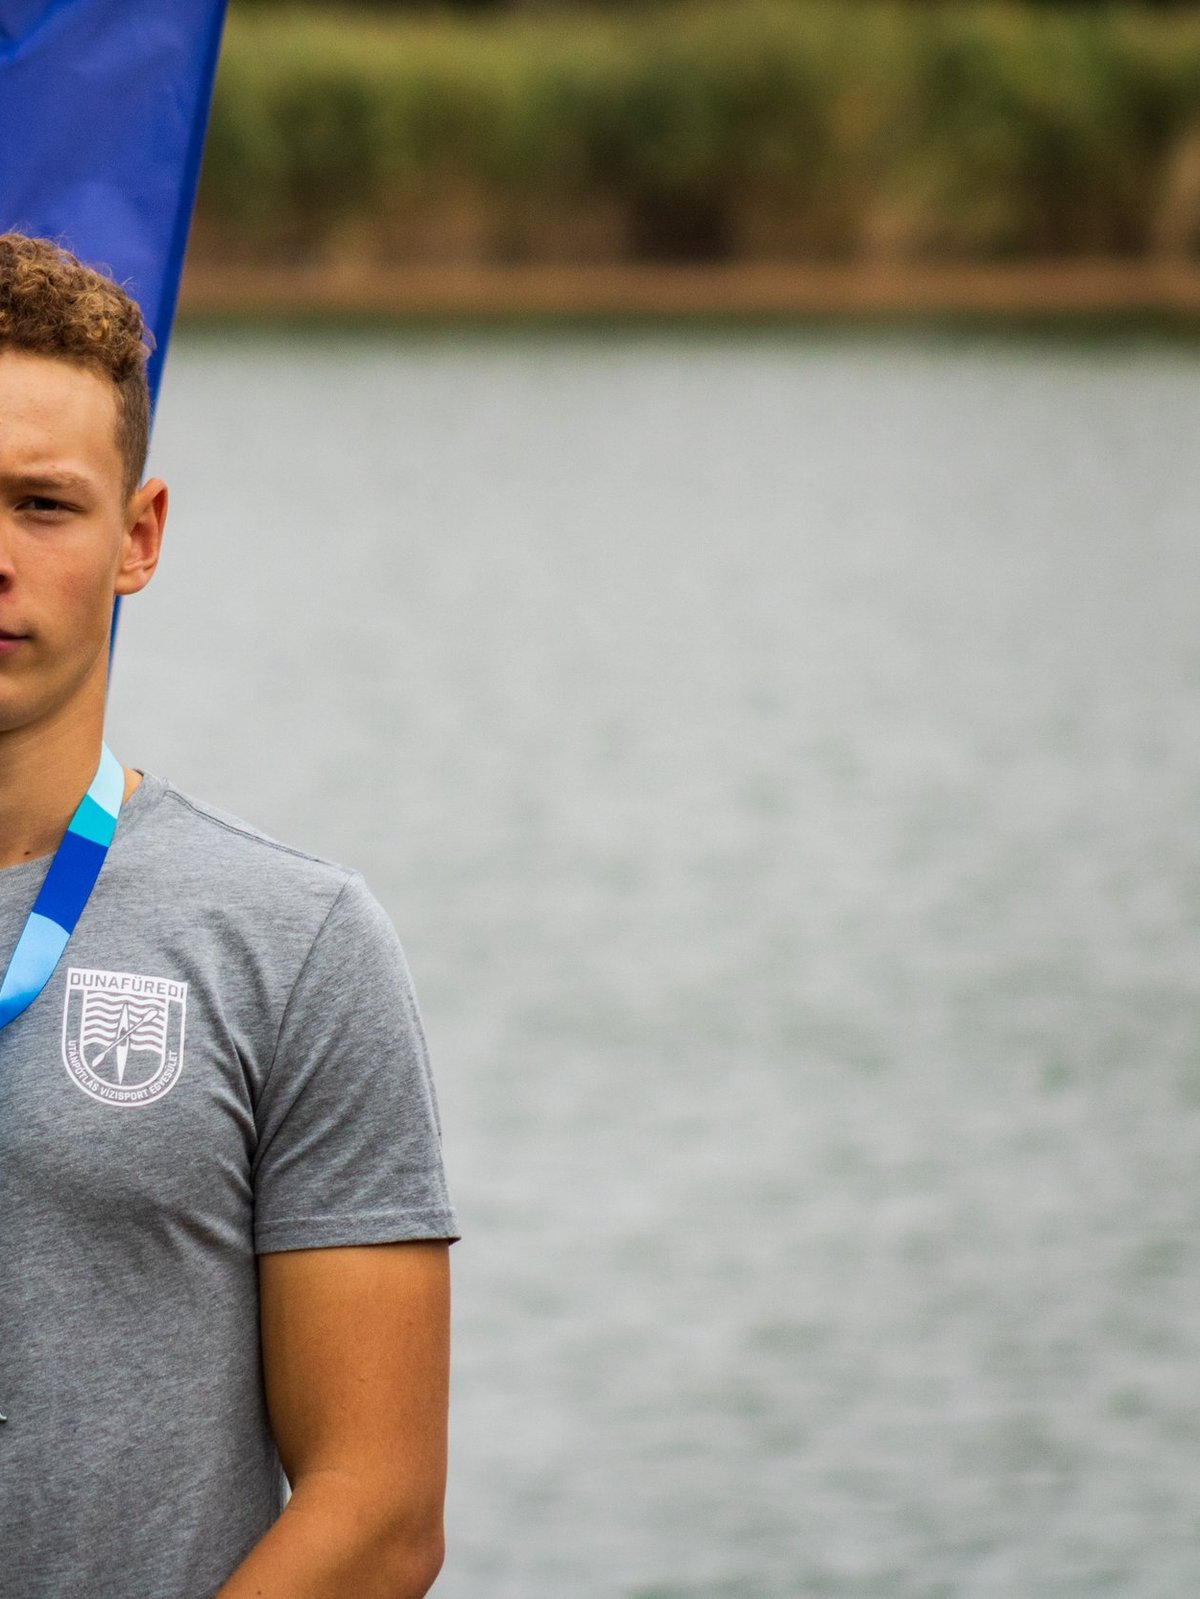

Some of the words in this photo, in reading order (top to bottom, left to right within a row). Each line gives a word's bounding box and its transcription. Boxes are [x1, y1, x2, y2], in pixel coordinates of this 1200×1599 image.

[70, 972, 185, 999] DUNAFÜREDI
[67, 1039, 99, 1092] UTÁNPÓTLÁS
[100, 1086, 149, 1101] VÍZISPORT
[150, 1051, 179, 1095] EGYESÜLET
